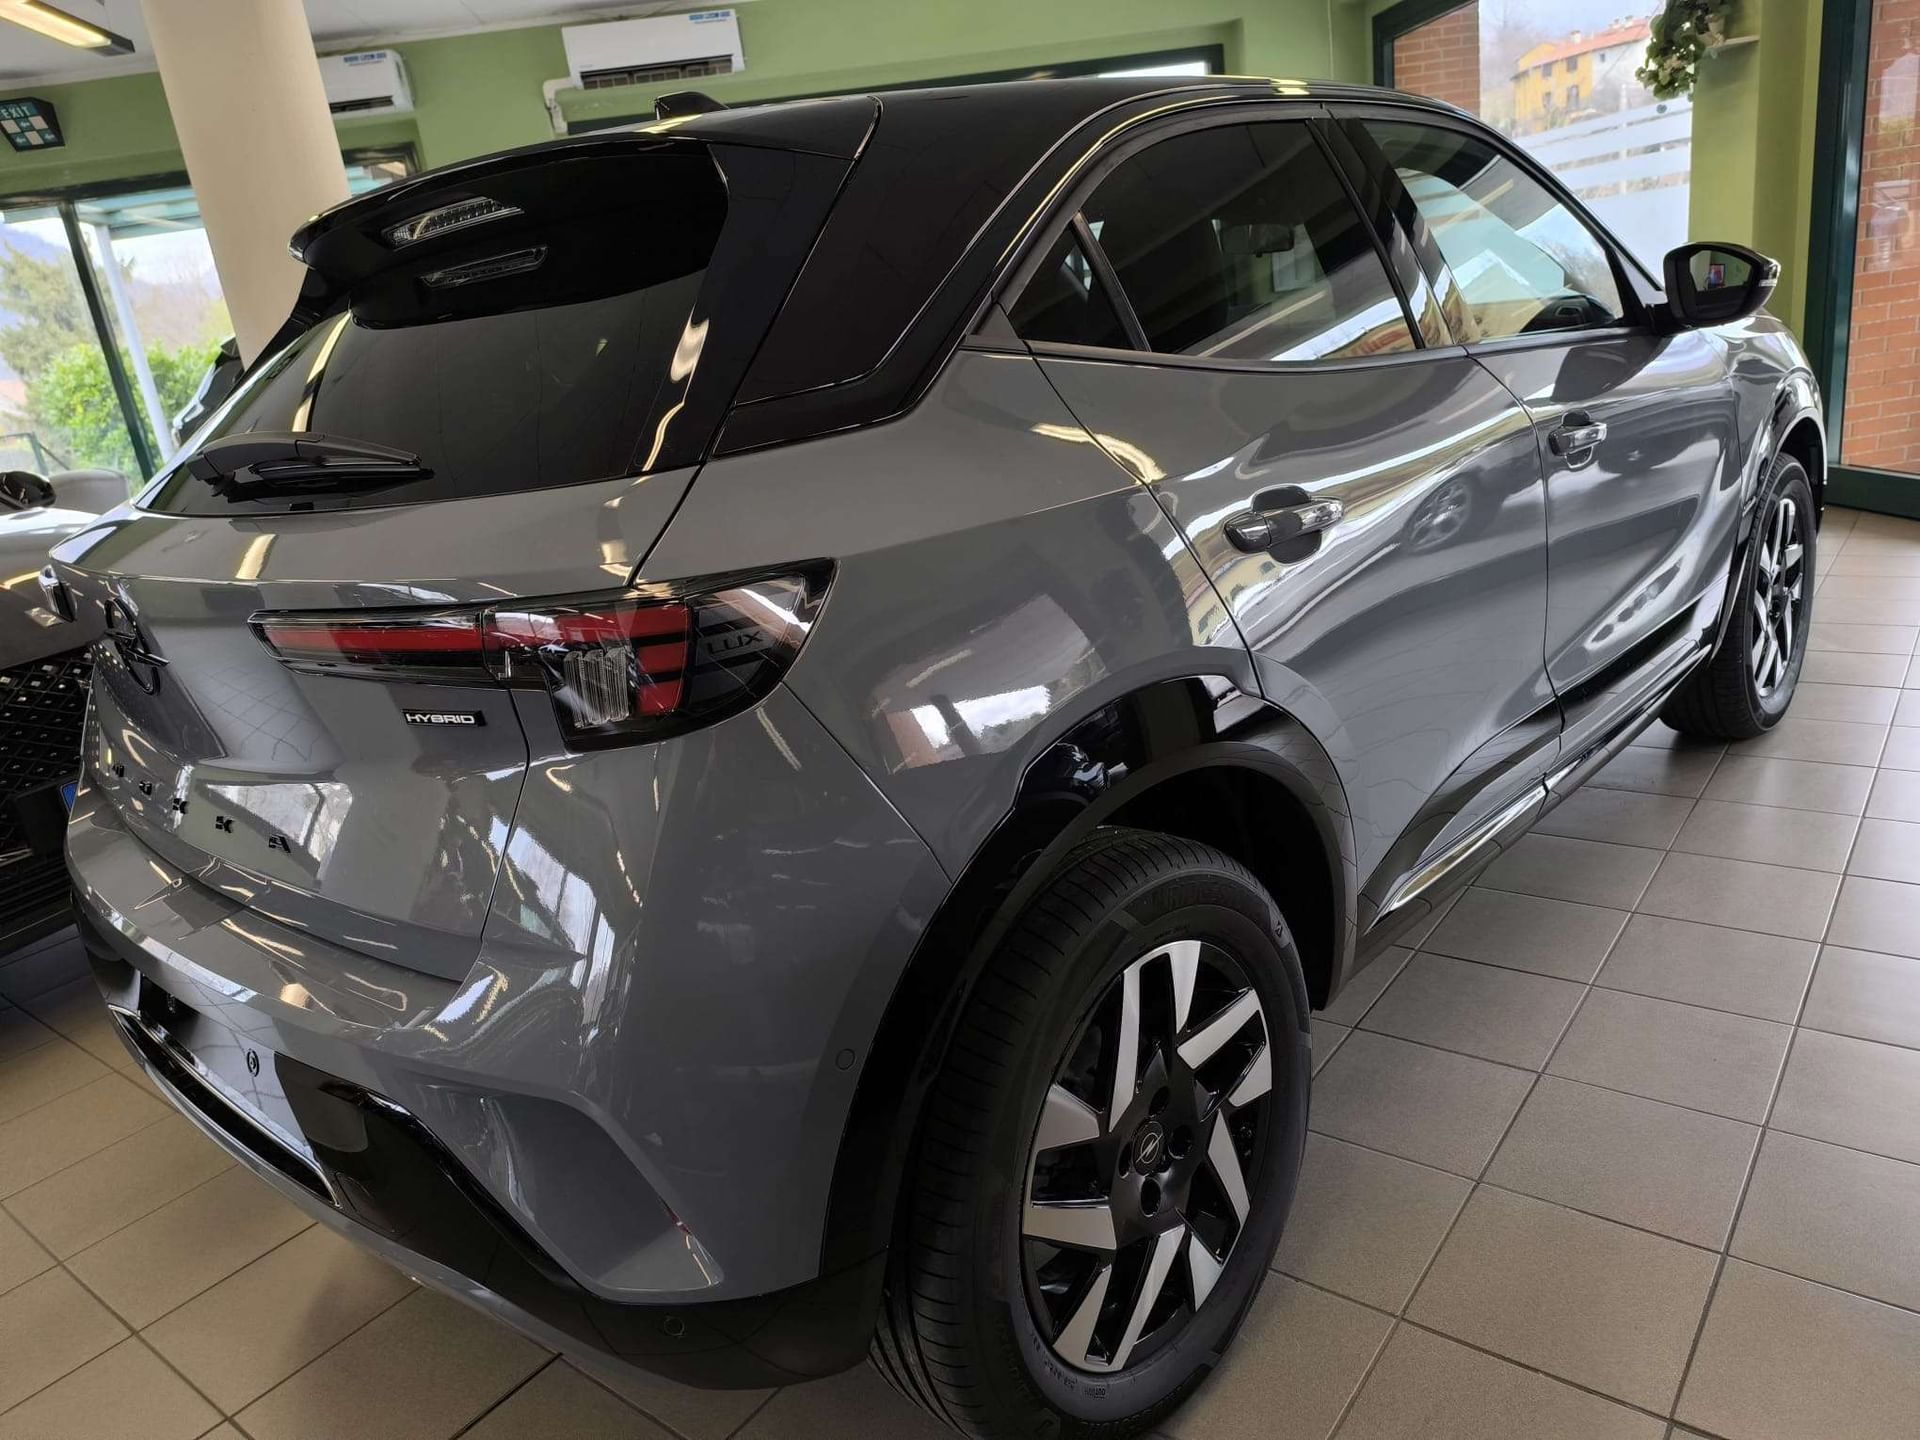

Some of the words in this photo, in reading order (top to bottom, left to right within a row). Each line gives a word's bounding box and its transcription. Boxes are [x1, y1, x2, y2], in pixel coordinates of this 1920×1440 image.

[1, 106, 30, 119] EXIT
[707, 630, 763, 654] LUX
[405, 713, 475, 724] HYBRID
